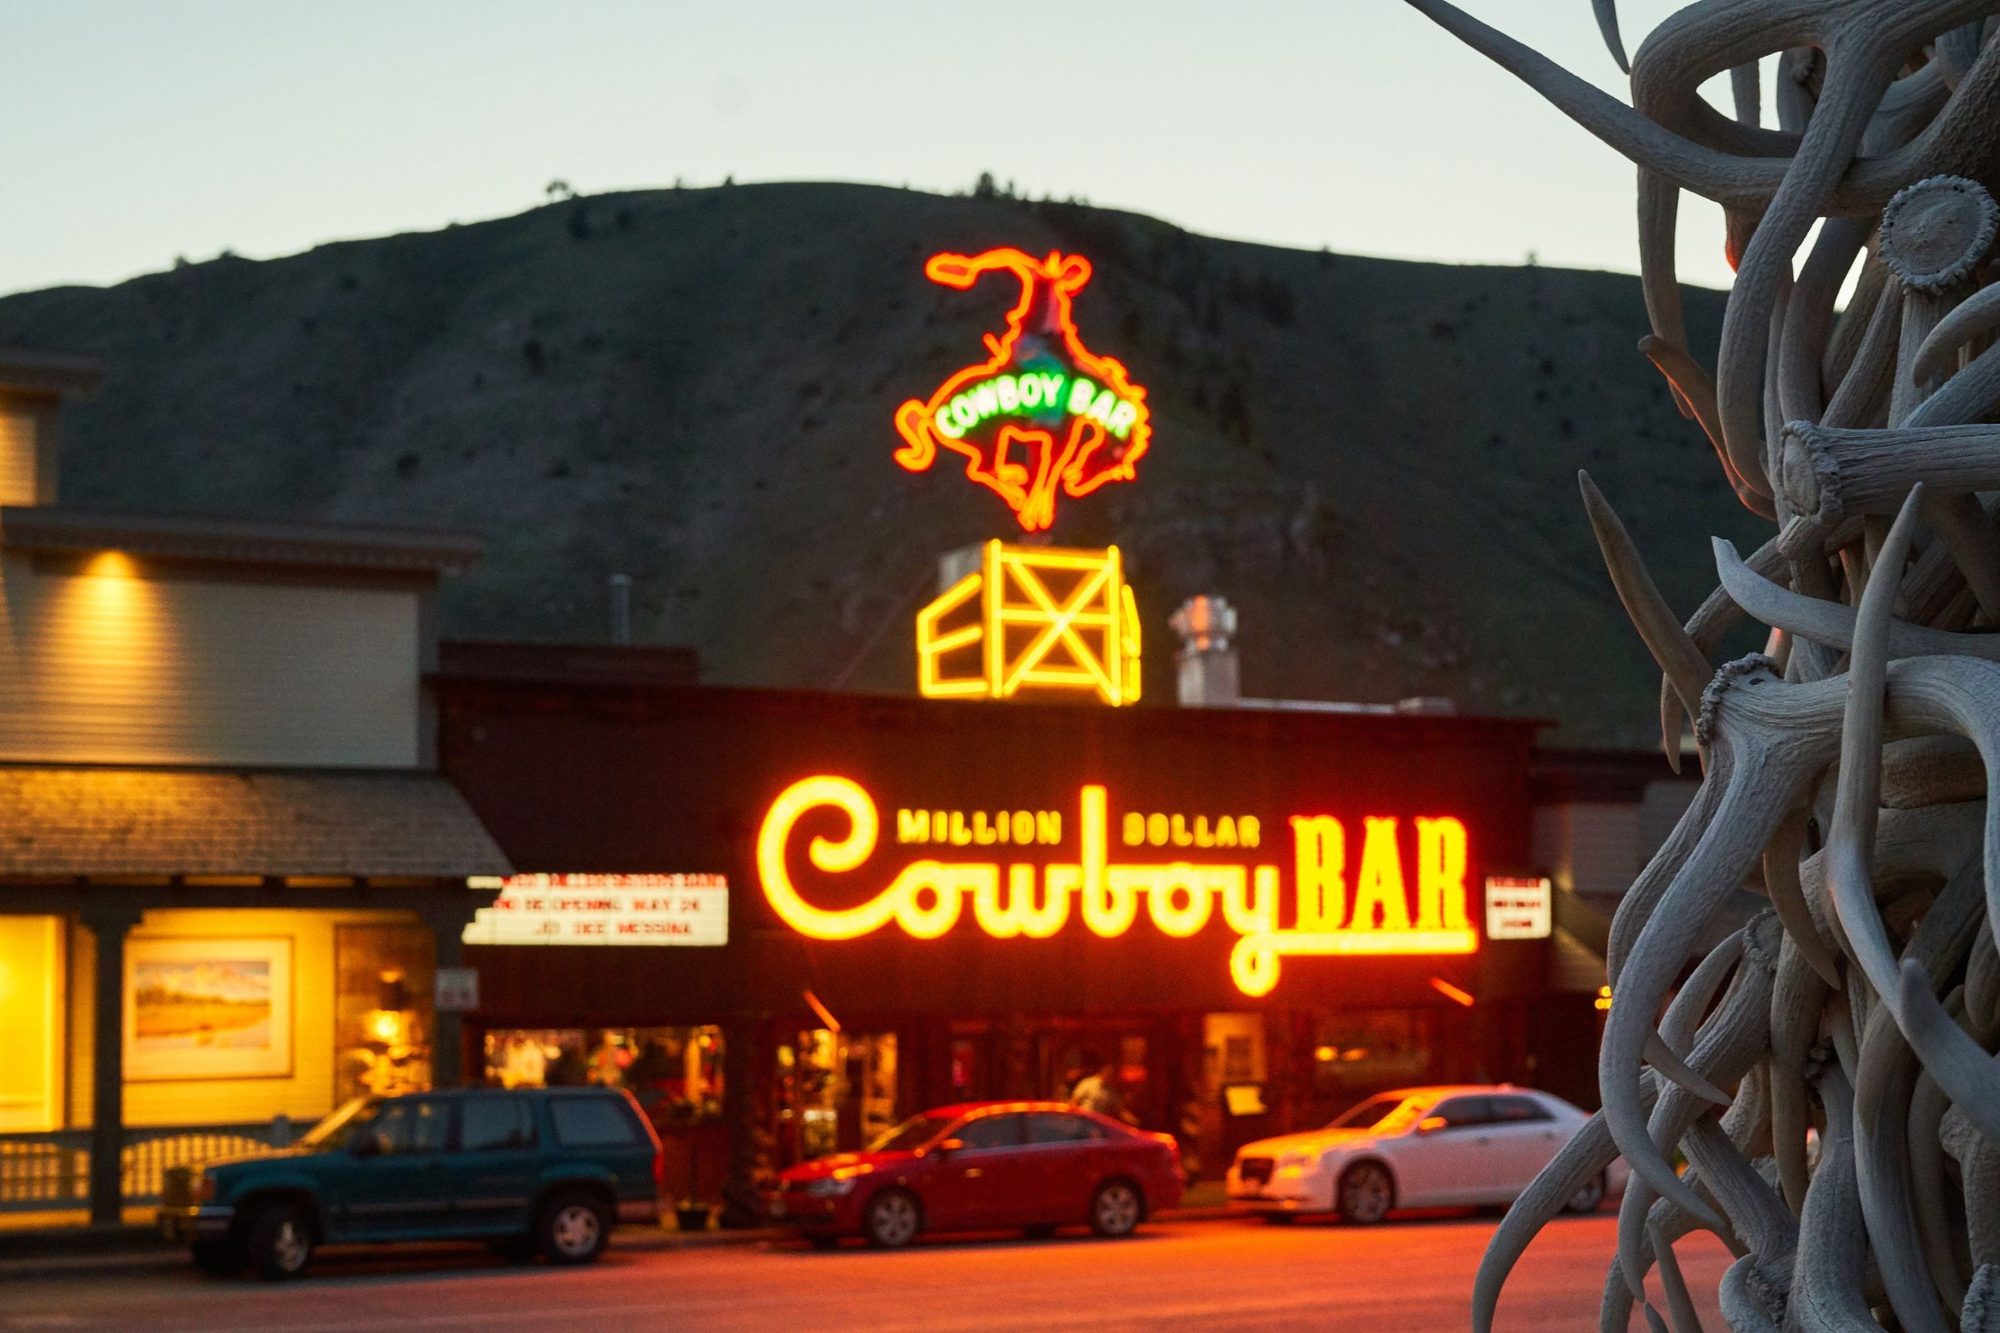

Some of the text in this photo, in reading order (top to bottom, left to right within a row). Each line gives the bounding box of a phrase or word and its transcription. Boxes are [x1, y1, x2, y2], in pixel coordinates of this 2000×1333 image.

[935, 373, 1137, 438] COWBOY BAR
[897, 808, 1261, 847] MILLION DOLLAR
[756, 774, 1470, 997] Cowboy BAR
